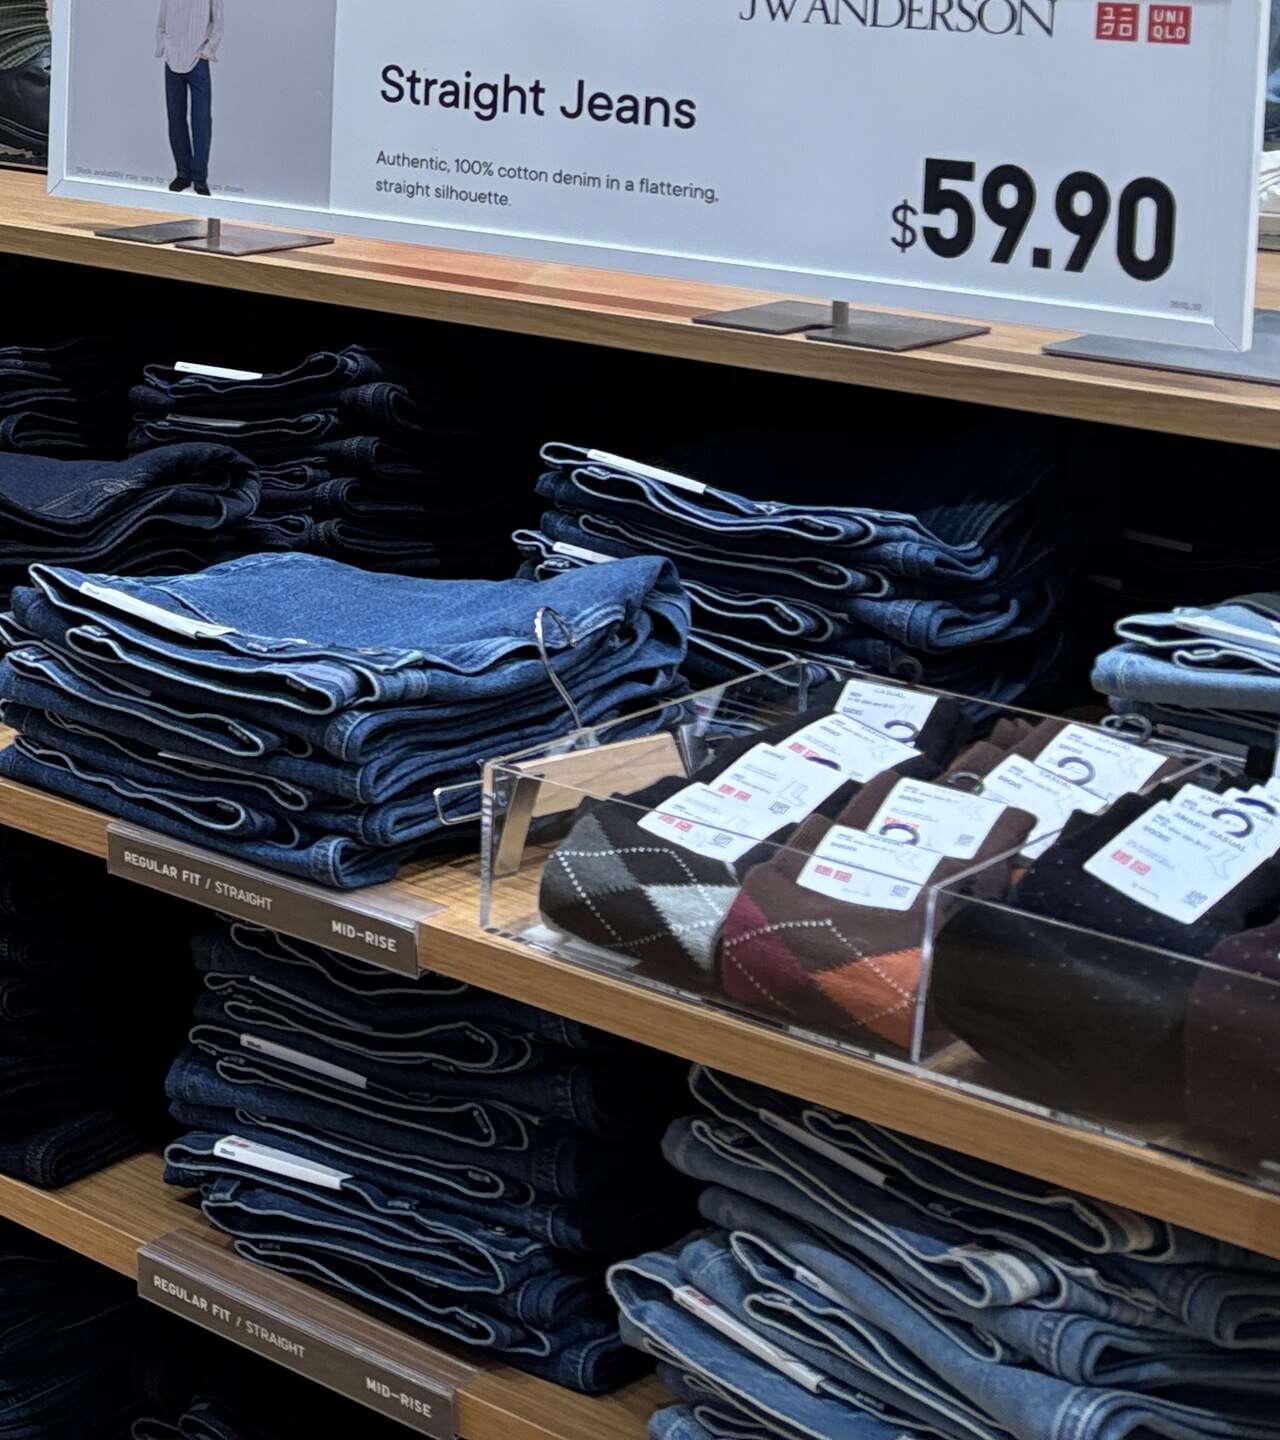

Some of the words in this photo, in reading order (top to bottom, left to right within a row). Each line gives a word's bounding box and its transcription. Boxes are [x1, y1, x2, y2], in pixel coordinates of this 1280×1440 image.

[380, 64, 546, 122] Straight
[559, 78, 697, 129] Jeans
[375, 178, 431, 204] straight
[434, 183, 512, 208] silhouette.
[376, 151, 451, 175] Authentic,
[454, 159, 495, 177] 100%
[498, 164, 549, 183] cotton
[552, 169, 602, 189] denim
[605, 176, 621, 191] in
[625, 180, 635, 192] a
[890, 157, 1177, 282] $59.90
[124, 850, 179, 880] REGULAR
[183, 869, 202, 889] FIT
[214, 880, 273, 911] STRAIGHT
[331, 920, 398, 954] MID-RISE
[153, 1275, 209, 1313] REGULAR
[212, 1303, 232, 1324] FIT
[244, 1319, 306, 1358] STRAIGHT
[366, 1376, 433, 1419] MID-RISE
